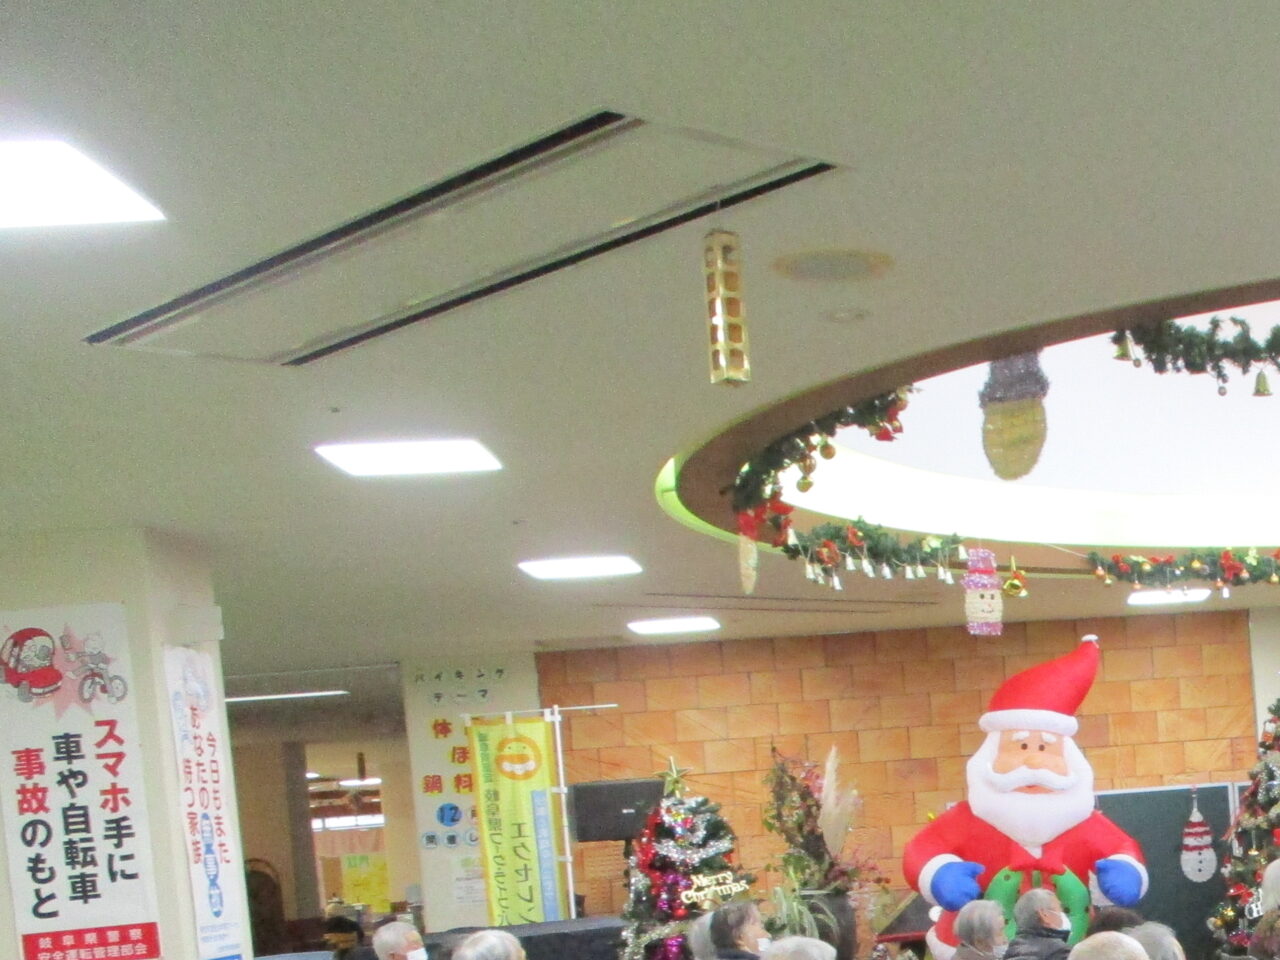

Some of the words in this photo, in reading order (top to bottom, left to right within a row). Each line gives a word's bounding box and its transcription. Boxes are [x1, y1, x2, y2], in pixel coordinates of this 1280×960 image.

[11, 748, 60, 919] 事故のもと
[52, 733, 101, 904] 車や自転車
[94, 718, 139, 882] スマホ手に
